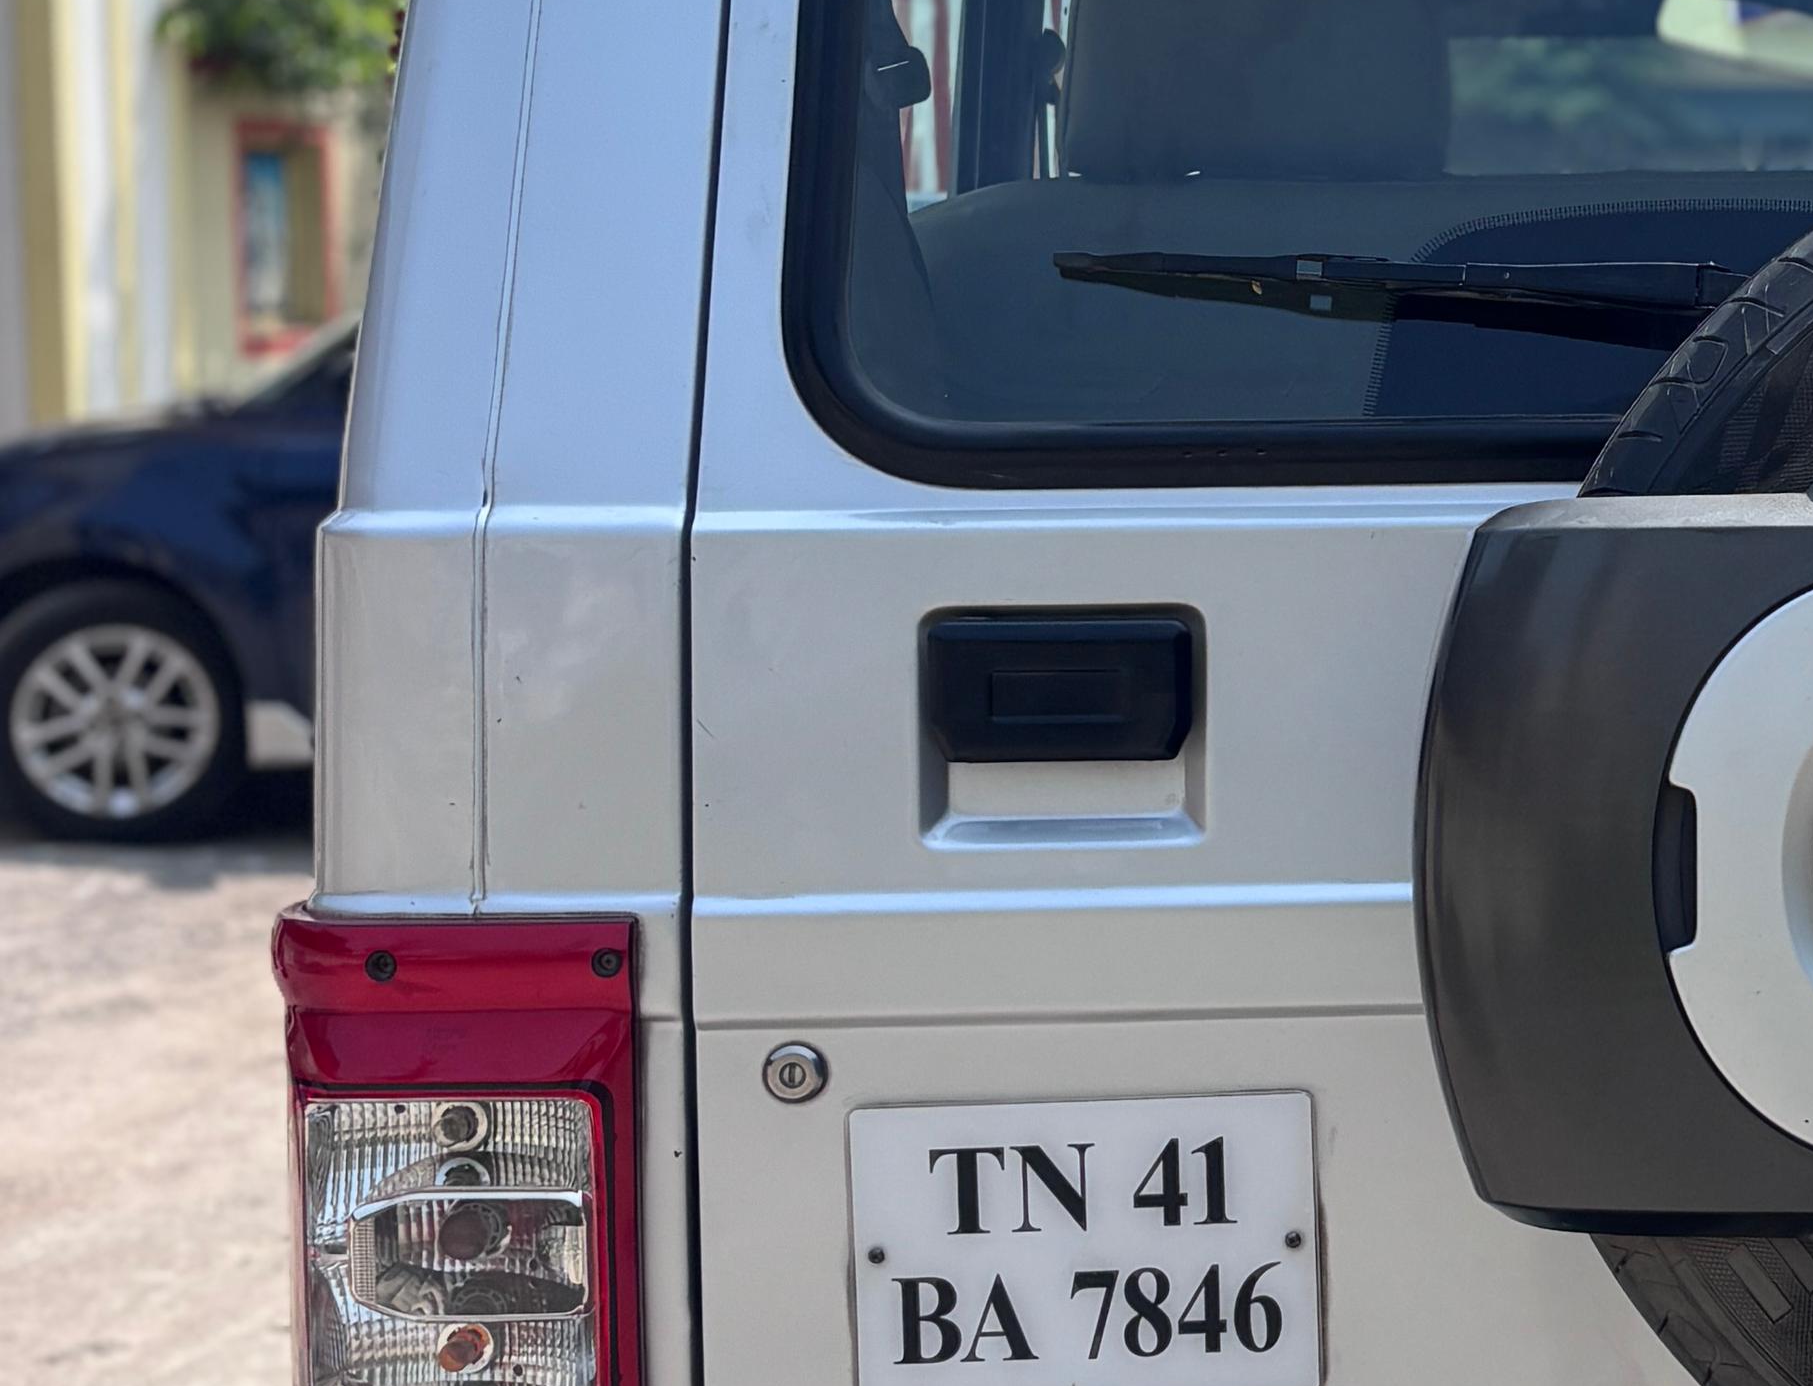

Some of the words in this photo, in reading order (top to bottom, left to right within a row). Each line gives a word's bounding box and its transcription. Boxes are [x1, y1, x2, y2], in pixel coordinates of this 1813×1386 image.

[929, 1142, 1095, 1235] TN
[1133, 1135, 1238, 1227] 41
[891, 1273, 1040, 1365] BA
[1070, 1261, 1283, 1360] 7846
